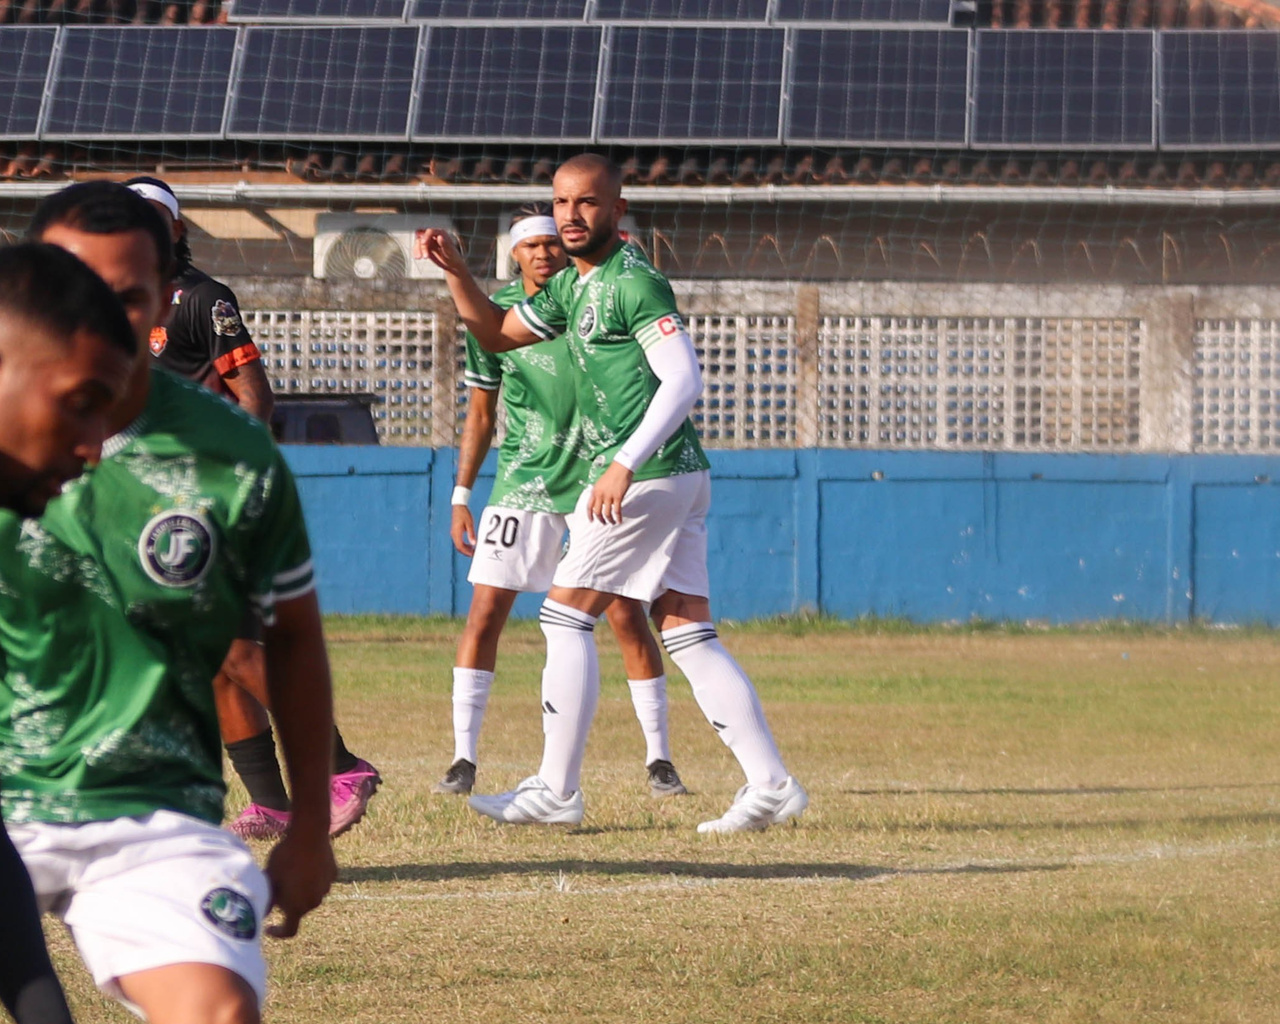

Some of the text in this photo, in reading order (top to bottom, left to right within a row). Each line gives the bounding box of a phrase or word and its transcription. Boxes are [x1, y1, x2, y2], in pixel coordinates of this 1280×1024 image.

[658, 317, 676, 336] C
[484, 514, 519, 548] 20
[160, 533, 196, 566] JF
